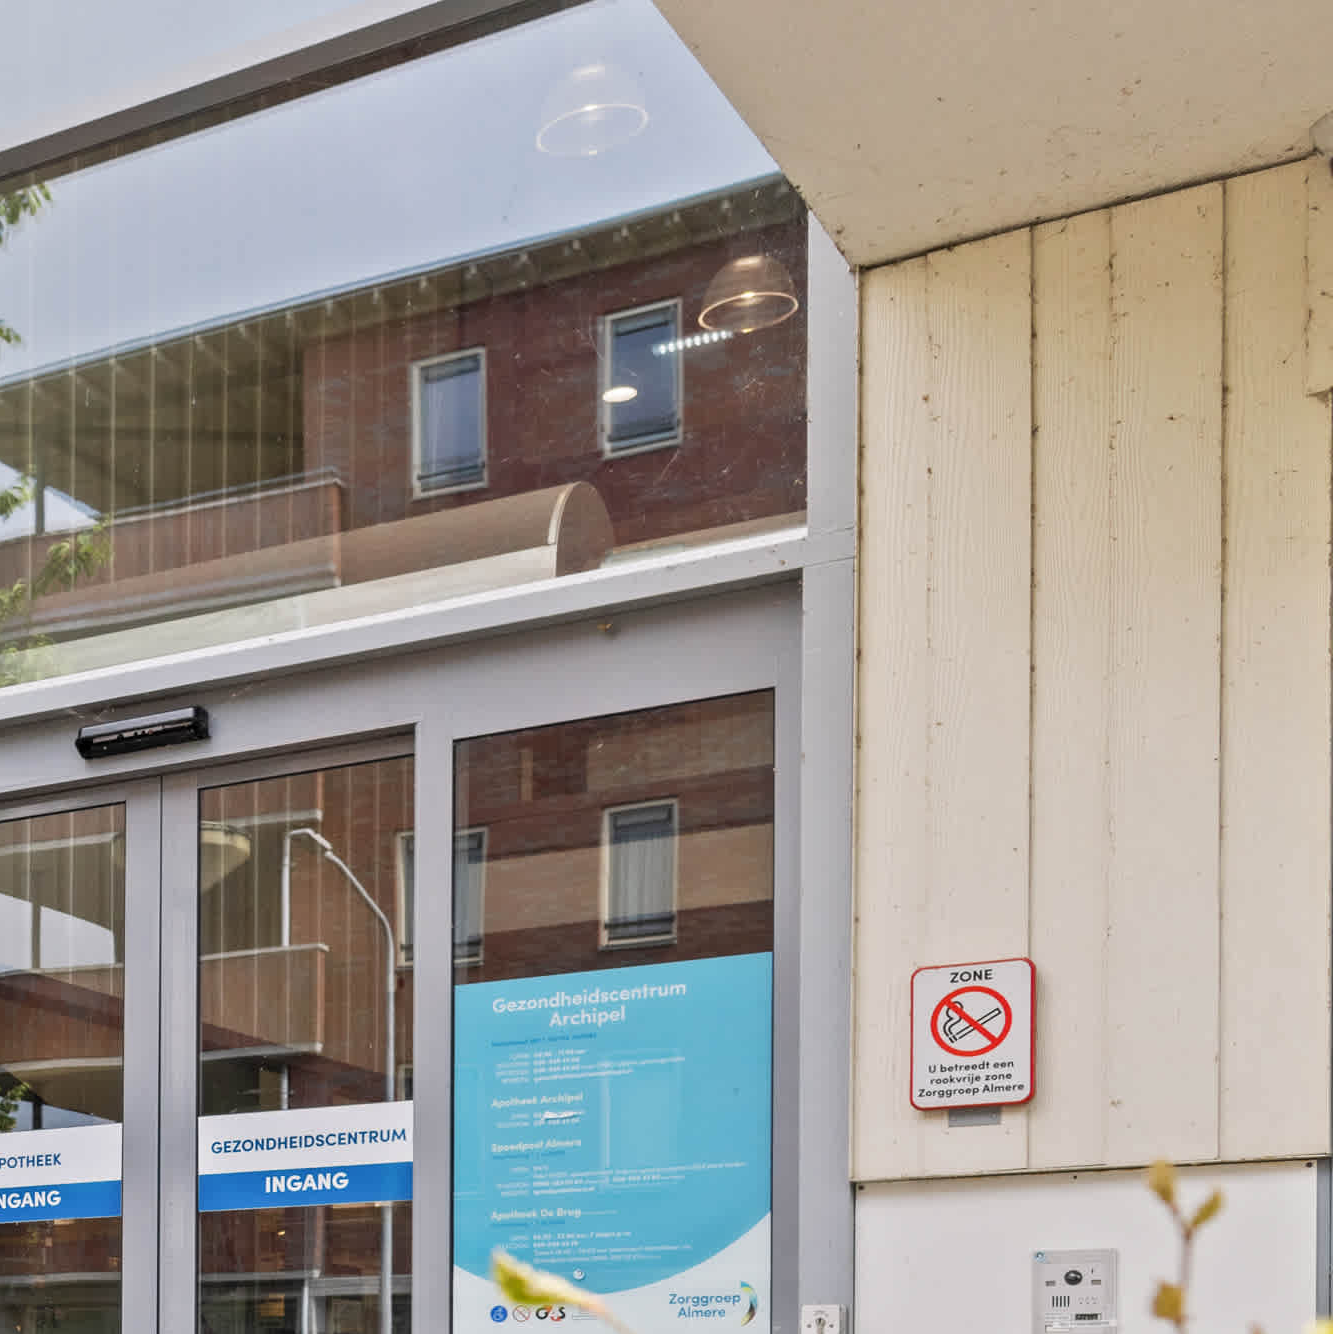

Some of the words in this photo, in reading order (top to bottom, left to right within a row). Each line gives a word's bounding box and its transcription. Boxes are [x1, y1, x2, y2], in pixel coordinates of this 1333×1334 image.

[949, 968, 994, 984] ZONE
[492, 983, 687, 1014] Gezondheidscentrum
[548, 1005, 626, 1027] Archipel
[927, 1065, 937, 1074] U
[939, 1061, 990, 1073] betreedt
[992, 1060, 1015, 1069] een
[929, 1074, 982, 1085] rookvrije
[984, 1072, 1013, 1082] zone
[540, 1090, 584, 1105] Archipel
[917, 1087, 980, 1098] Zorggroep
[982, 1083, 1025, 1093] Almere
[211, 1128, 407, 1154] GEZONDHEIDSCENTRUM
[265, 1172, 349, 1193] INGANG
[668, 1293, 741, 1307] Zorggroep
[677, 1306, 726, 1318] Almere
